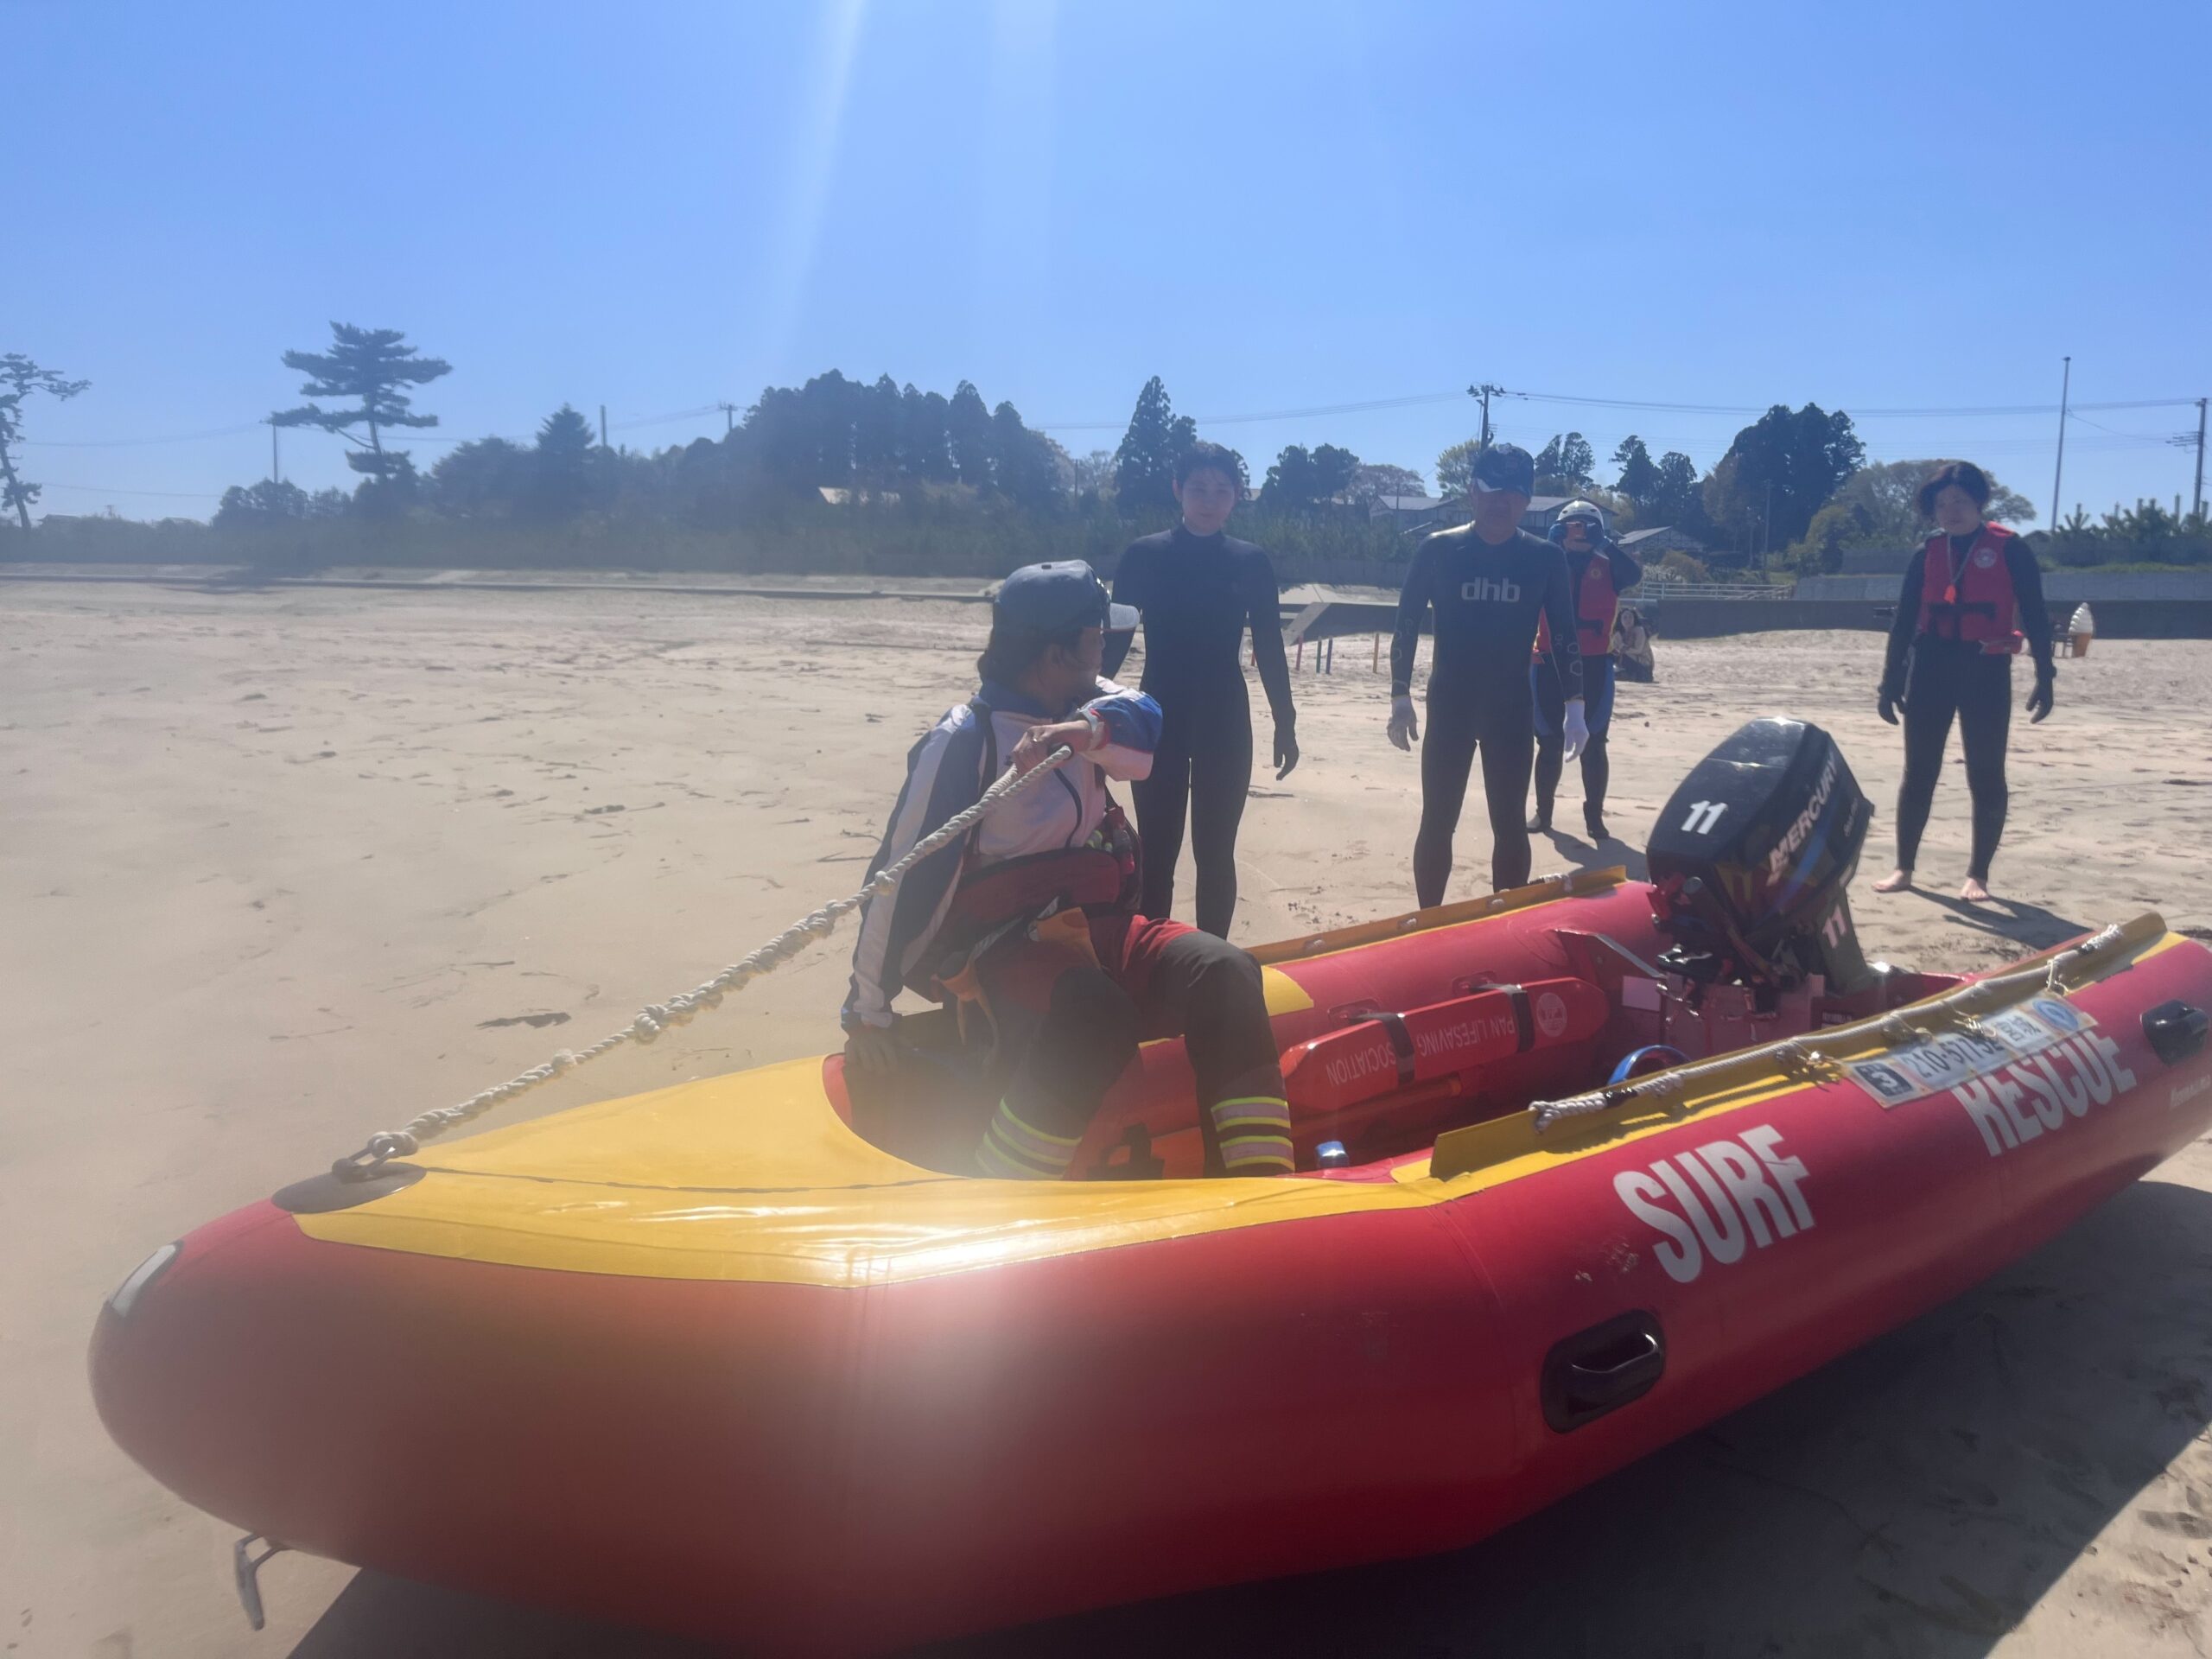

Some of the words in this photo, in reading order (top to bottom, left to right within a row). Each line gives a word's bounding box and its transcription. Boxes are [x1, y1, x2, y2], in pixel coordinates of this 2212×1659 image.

[1461, 576, 1521, 601] dhb
[1681, 799, 1728, 836] 11
[1765, 751, 1839, 887] MERCURY
[1821, 904, 1847, 950] 11
[1416, 1018, 1488, 1058] LIFESAVING
[1612, 1123, 1816, 1283] SURF
[1951, 1030, 2138, 1158] RESCUE
